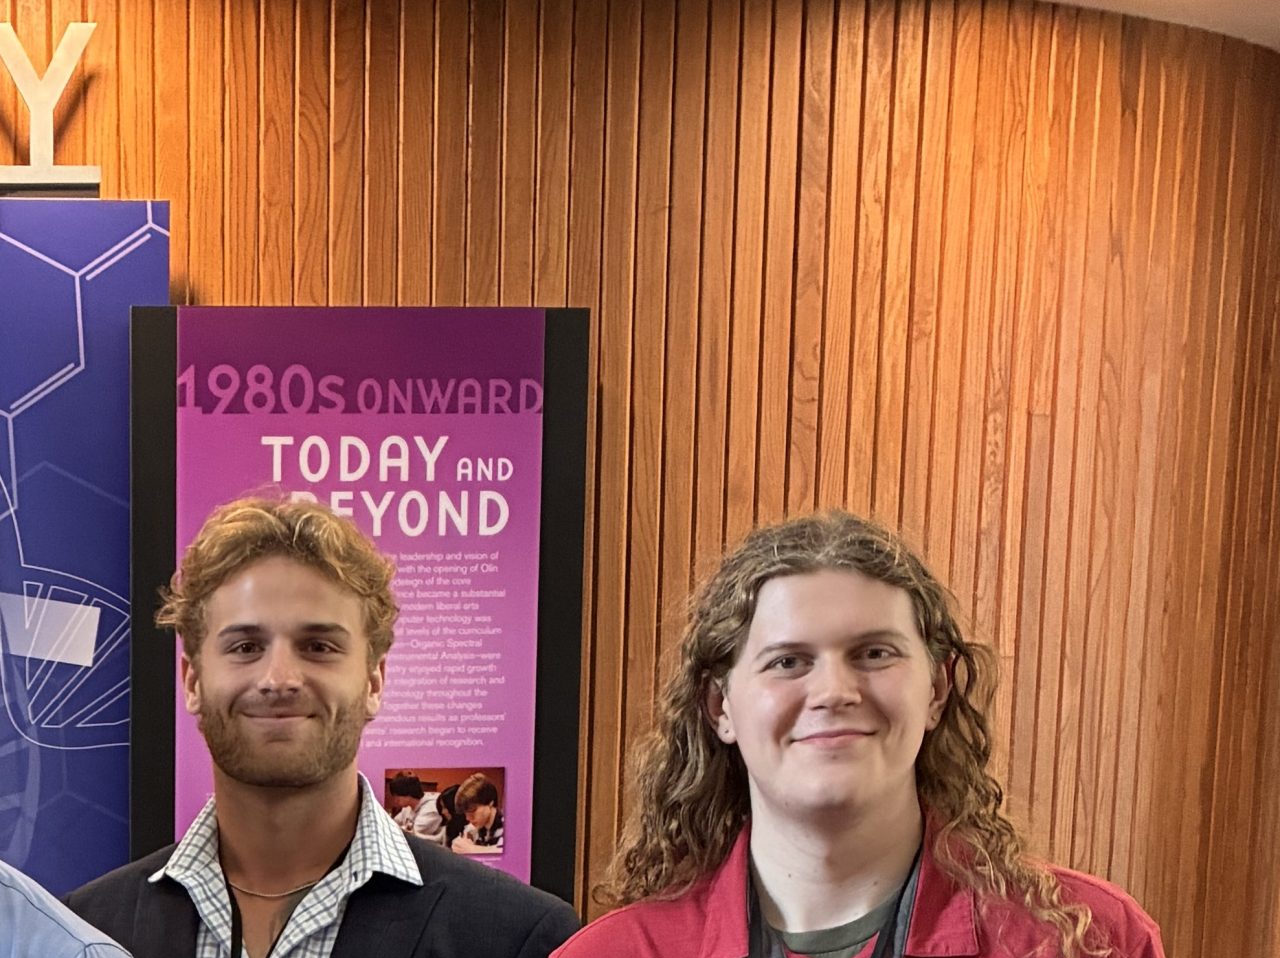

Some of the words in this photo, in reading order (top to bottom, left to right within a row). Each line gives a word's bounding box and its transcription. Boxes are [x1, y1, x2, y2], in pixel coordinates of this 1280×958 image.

[177, 364, 346, 414] 1980s
[357, 378, 543, 414] ONWARD
[261, 436, 449, 482] TODAY
[456, 457, 514, 482] AND
